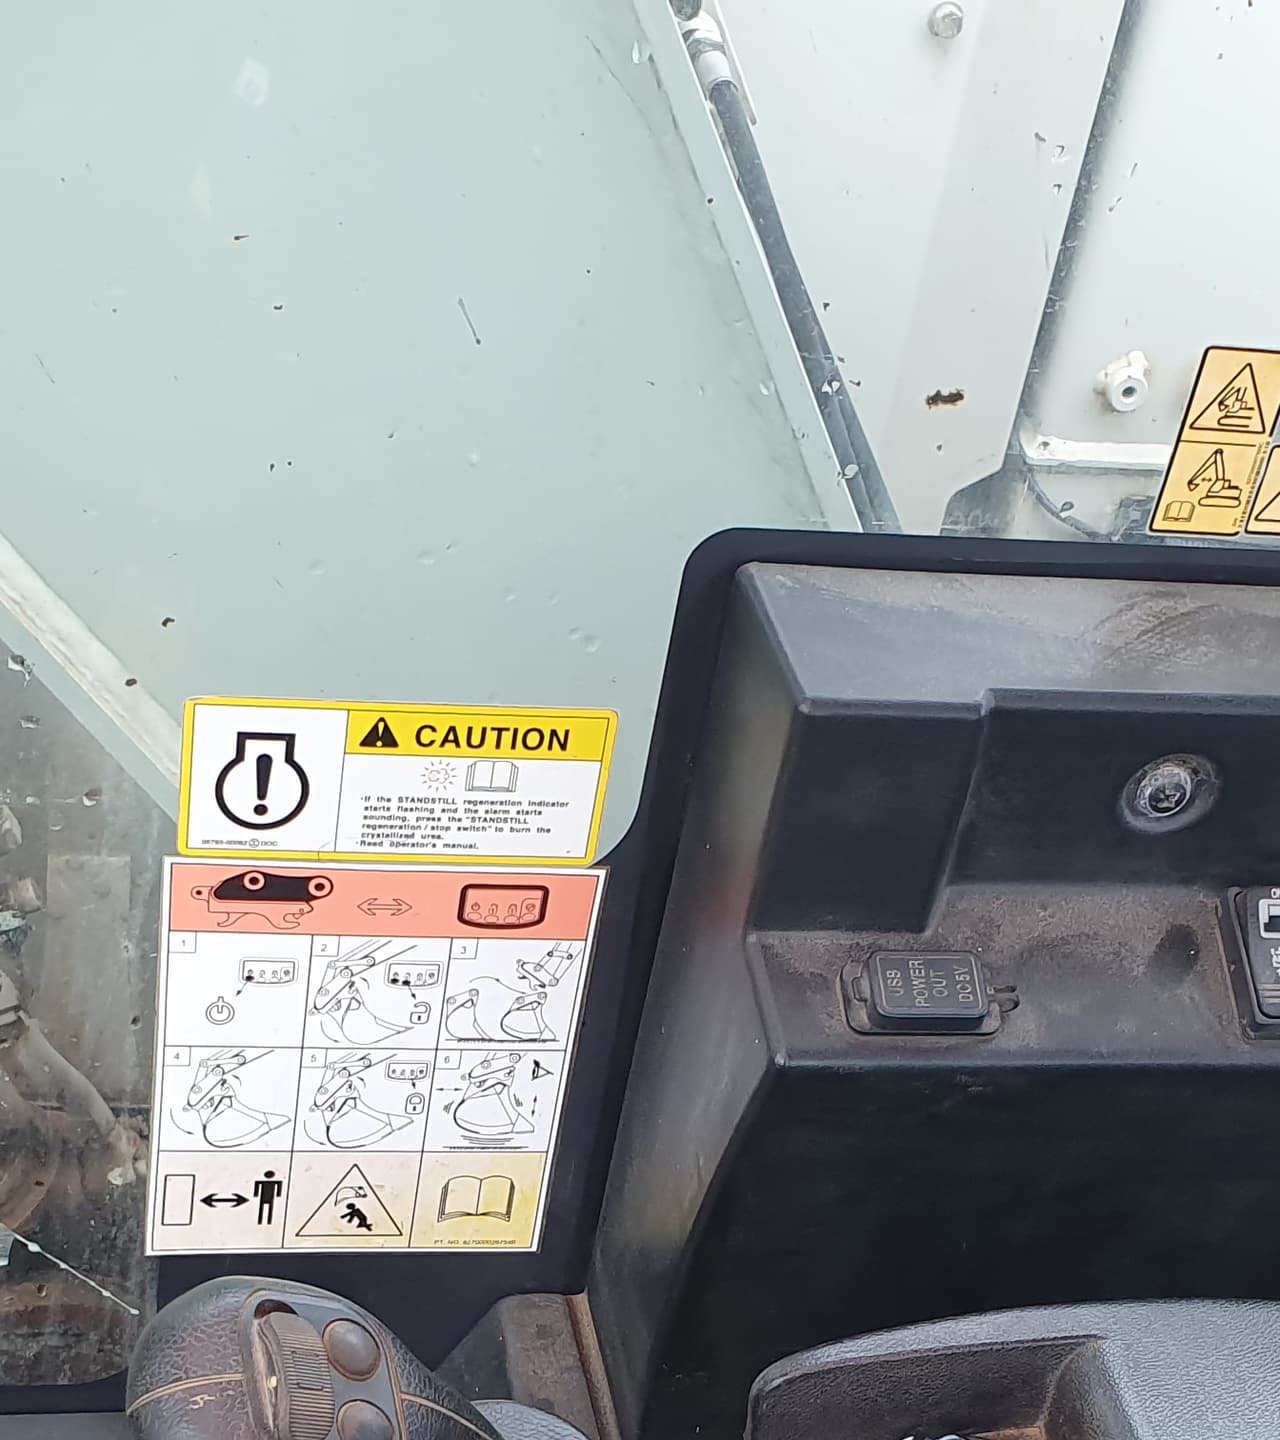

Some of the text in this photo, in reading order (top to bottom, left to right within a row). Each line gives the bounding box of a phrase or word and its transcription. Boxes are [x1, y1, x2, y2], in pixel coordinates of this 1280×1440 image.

[414, 724, 570, 752] CAUTION
[398, 796, 457, 805] STANDSTILL
[180, 938, 186, 947] 1
[320, 943, 327, 952] 2
[460, 945, 467, 955] 3
[887, 969, 904, 997] USB
[909, 960, 930, 1007] POWER
[930, 969, 948, 998] OUT
[173, 1052, 180, 1061] 4
[310, 1054, 317, 1063] 5
[443, 1056, 450, 1064] 6
